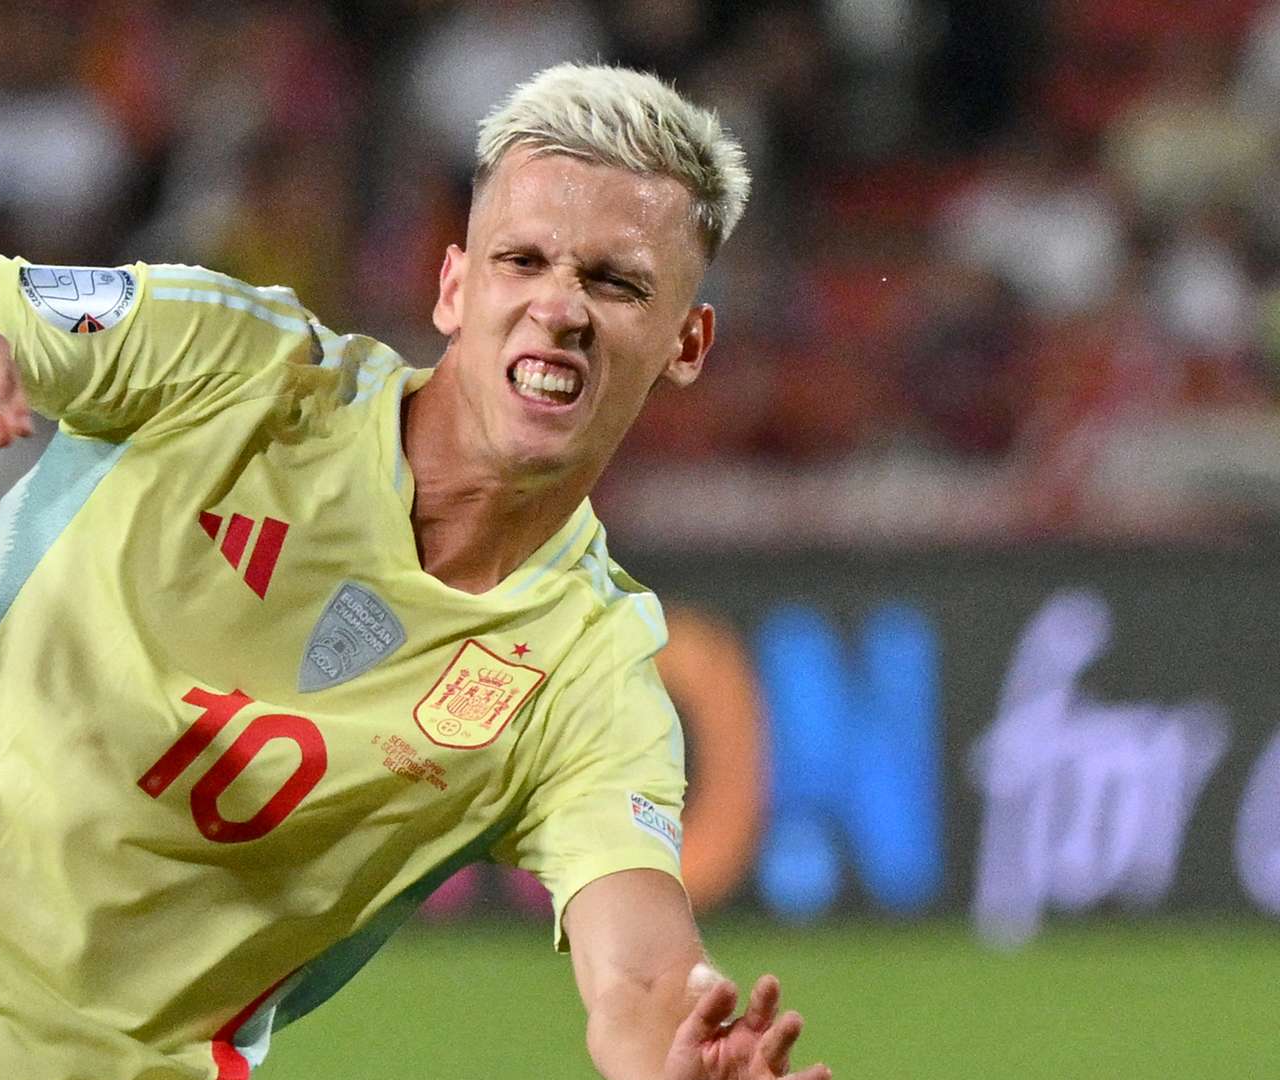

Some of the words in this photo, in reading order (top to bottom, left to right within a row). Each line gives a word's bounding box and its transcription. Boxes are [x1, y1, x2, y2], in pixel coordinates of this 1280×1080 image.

[333, 600, 384, 654] CHAMPIONS
[342, 592, 394, 645] EUROPEAN
[365, 598, 388, 622] UEFA
[309, 650, 338, 678] 2024
[136, 685, 329, 845] 10
[631, 794, 655, 811] UEFA
[632, 803, 677, 841] FOUN
